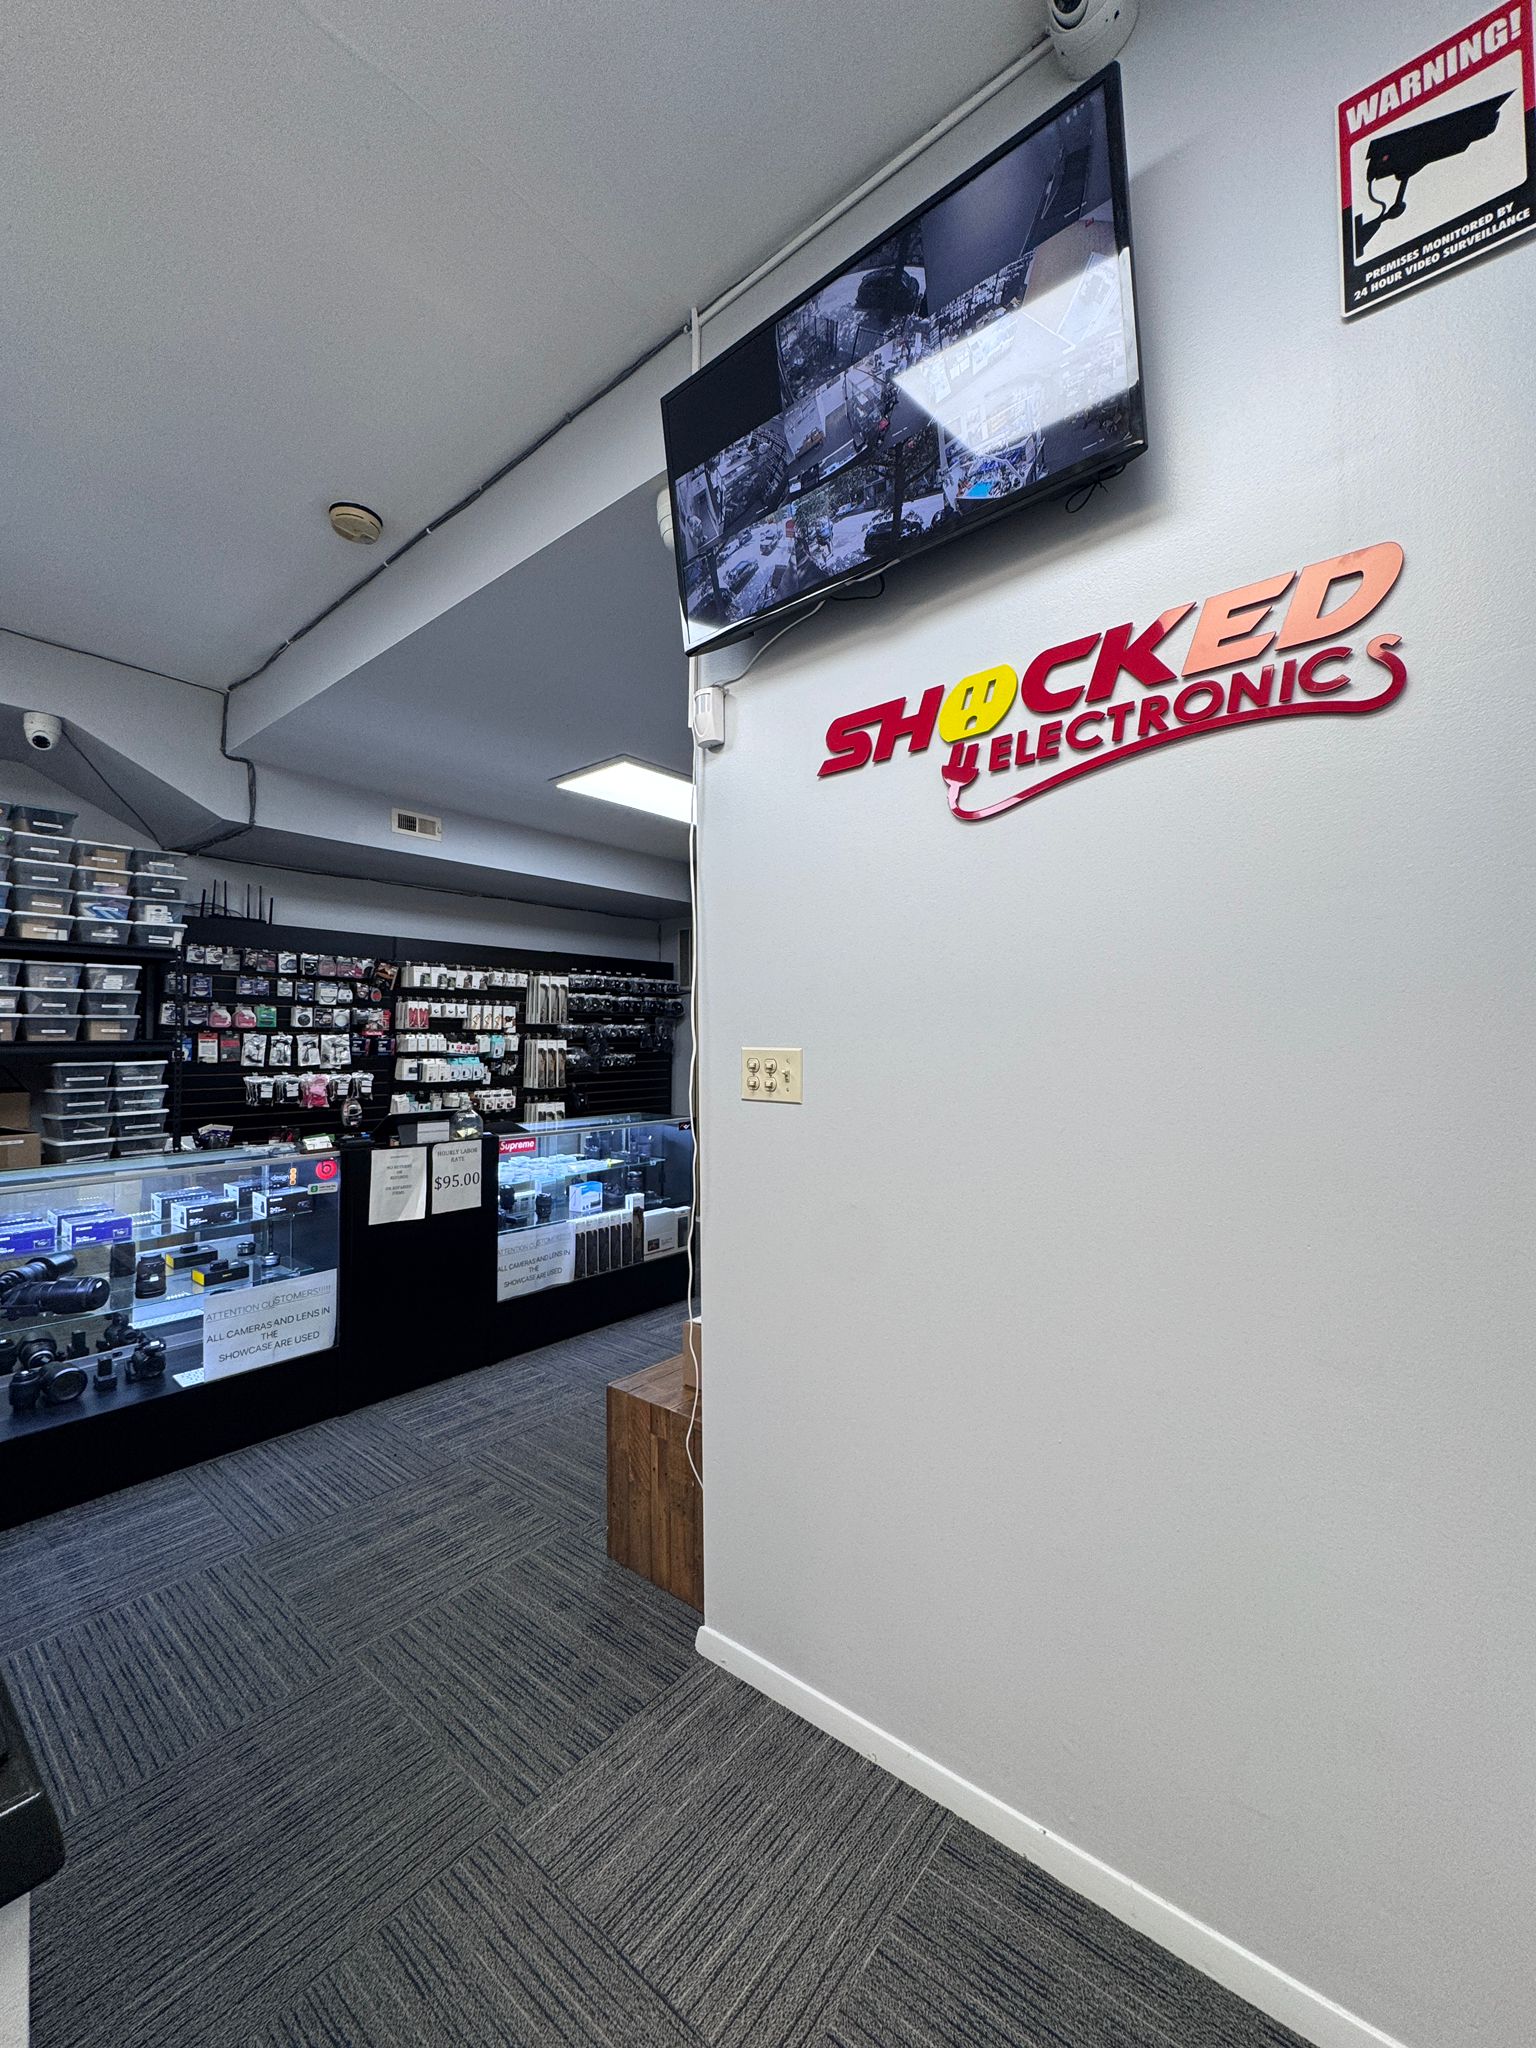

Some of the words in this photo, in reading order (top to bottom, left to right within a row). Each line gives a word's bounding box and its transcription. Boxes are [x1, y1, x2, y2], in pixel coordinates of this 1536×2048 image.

[1346, 6, 1523, 134] WARNING!
[1365, 249, 1420, 282] PREMISES
[1422, 212, 1494, 255] MONITORED
[1497, 202, 1515, 219] BY
[1354, 287, 1369, 301] 24
[1370, 271, 1403, 294] HOUR
[1405, 253, 1440, 276] VIDEO
[1442, 207, 1531, 259] SURVEILLANCE
[988, 633, 1408, 773] ELECTRONICS
[500, 1141, 535, 1152] Supreme
[434, 1172, 480, 1191] $95.00
[509, 1258, 535, 1270] CAMERAS
[537, 1254, 548, 1262] AND
[549, 1250, 562, 1260] LENS
[529, 1265, 539, 1273] THE
[504, 1275, 536, 1288] SHOWCASE
[206, 1303, 259, 1322] ATTENTION
[206, 1333, 224, 1344] ALL
[226, 1321, 273, 1339] CAMERAS
[274, 1315, 295, 1326] AND
[296, 1308, 320, 1322] LENS
[321, 1306, 331, 1315] IN
[261, 1330, 278, 1341] THE
[218, 1342, 273, 1363] SHOWCASE
[274, 1337, 293, 1349] ARE
[294, 1331, 320, 1344] USED
